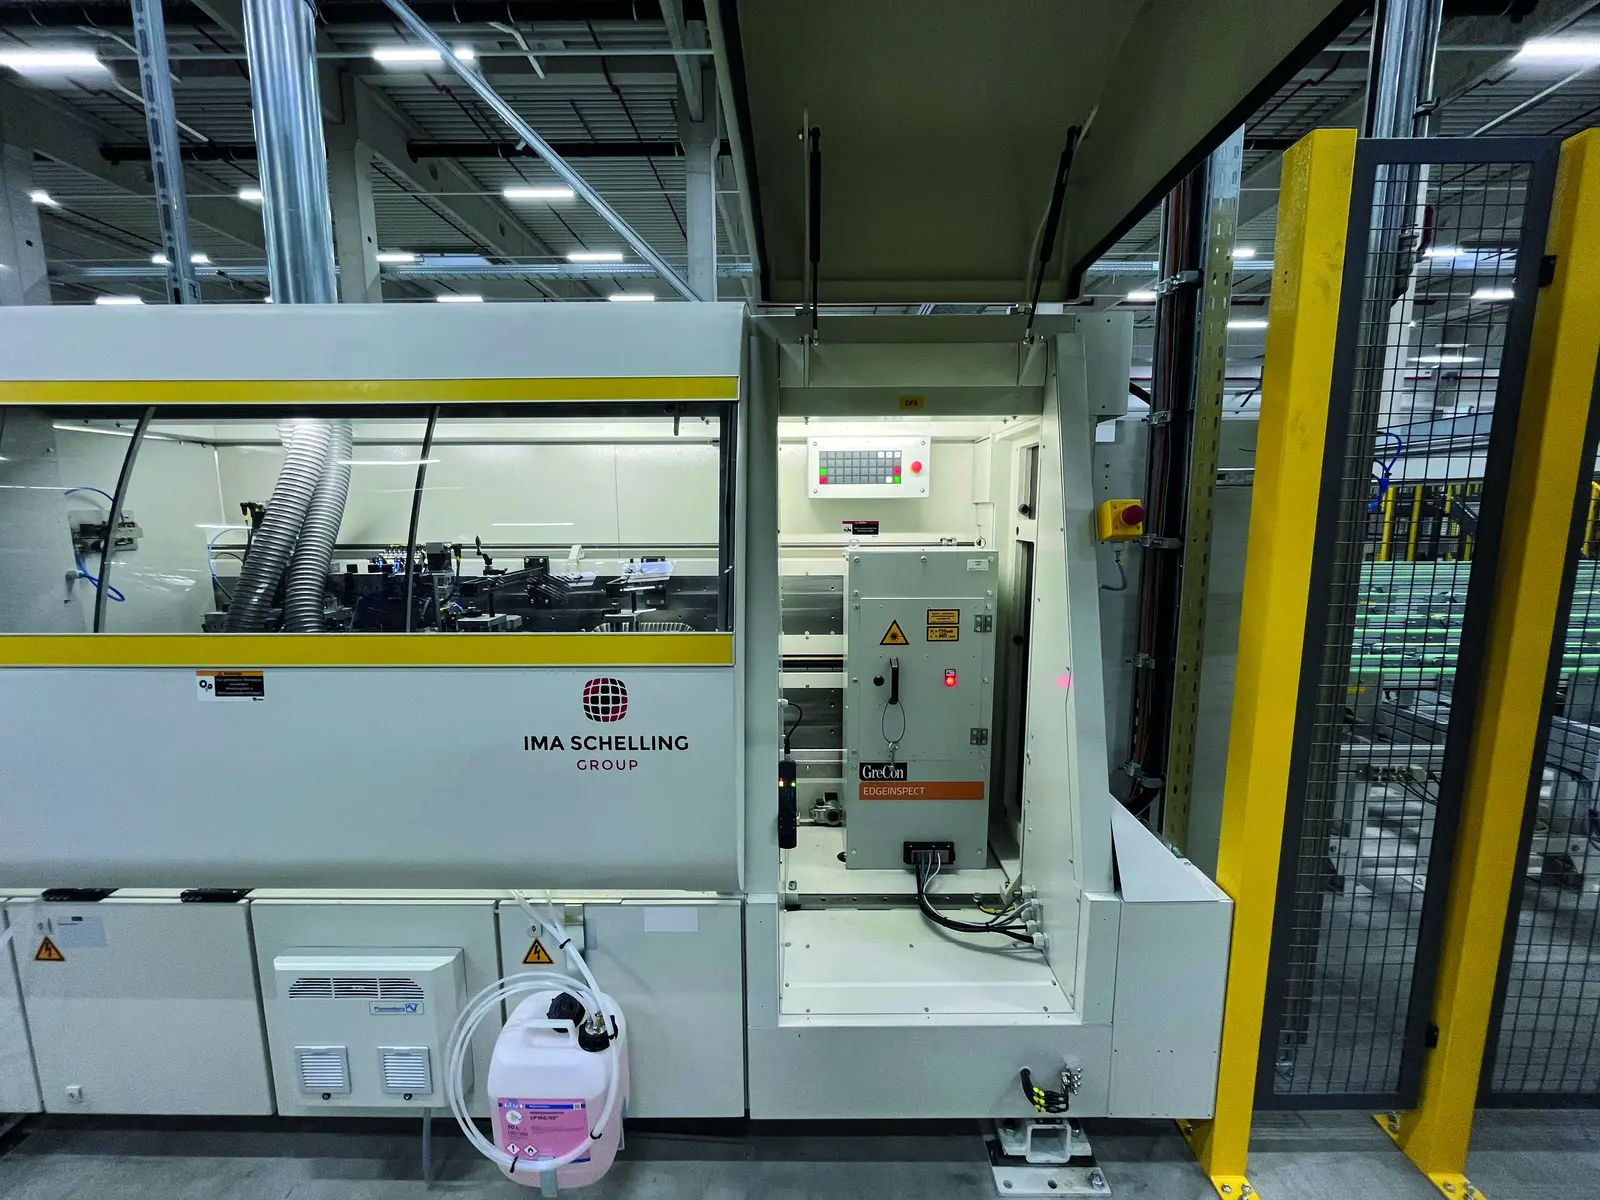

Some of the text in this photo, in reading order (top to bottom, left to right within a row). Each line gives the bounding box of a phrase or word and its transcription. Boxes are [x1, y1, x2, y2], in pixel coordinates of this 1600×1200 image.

[523, 735, 689, 751] IMA SCHELLING
[576, 759, 639, 771] GROUP
[862, 763, 904, 780] GreCon
[863, 786, 925, 797] EDGEINSPECT
